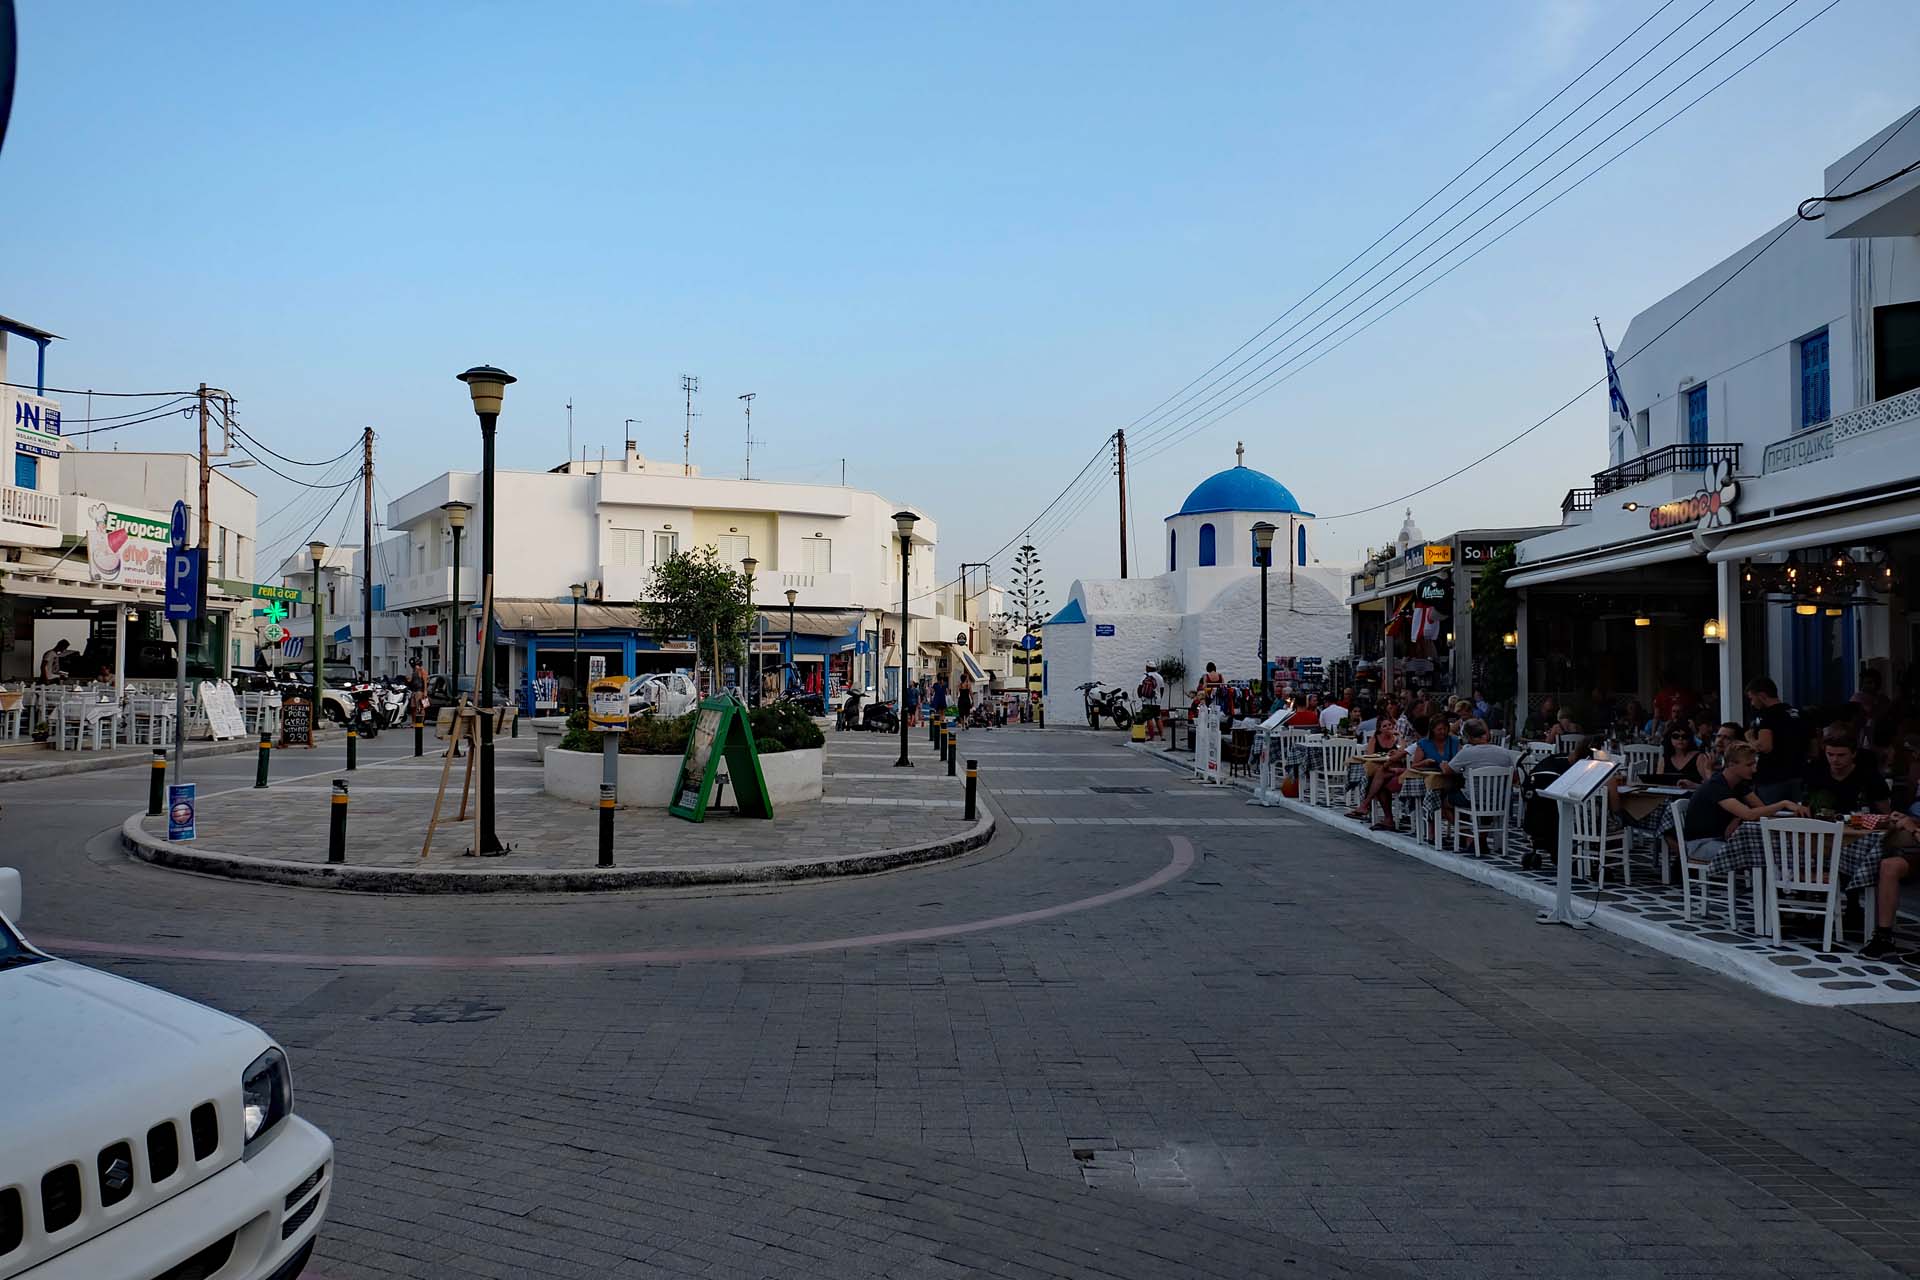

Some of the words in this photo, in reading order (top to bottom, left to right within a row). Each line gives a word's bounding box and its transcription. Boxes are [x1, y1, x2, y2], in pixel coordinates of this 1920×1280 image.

[40, 448, 59, 458] ESTATE
[106, 513, 169, 541] Europcar
[174, 556, 190, 589] P
[258, 586, 276, 597] rent
[277, 589, 284, 598] a
[284, 590, 299, 600] car
